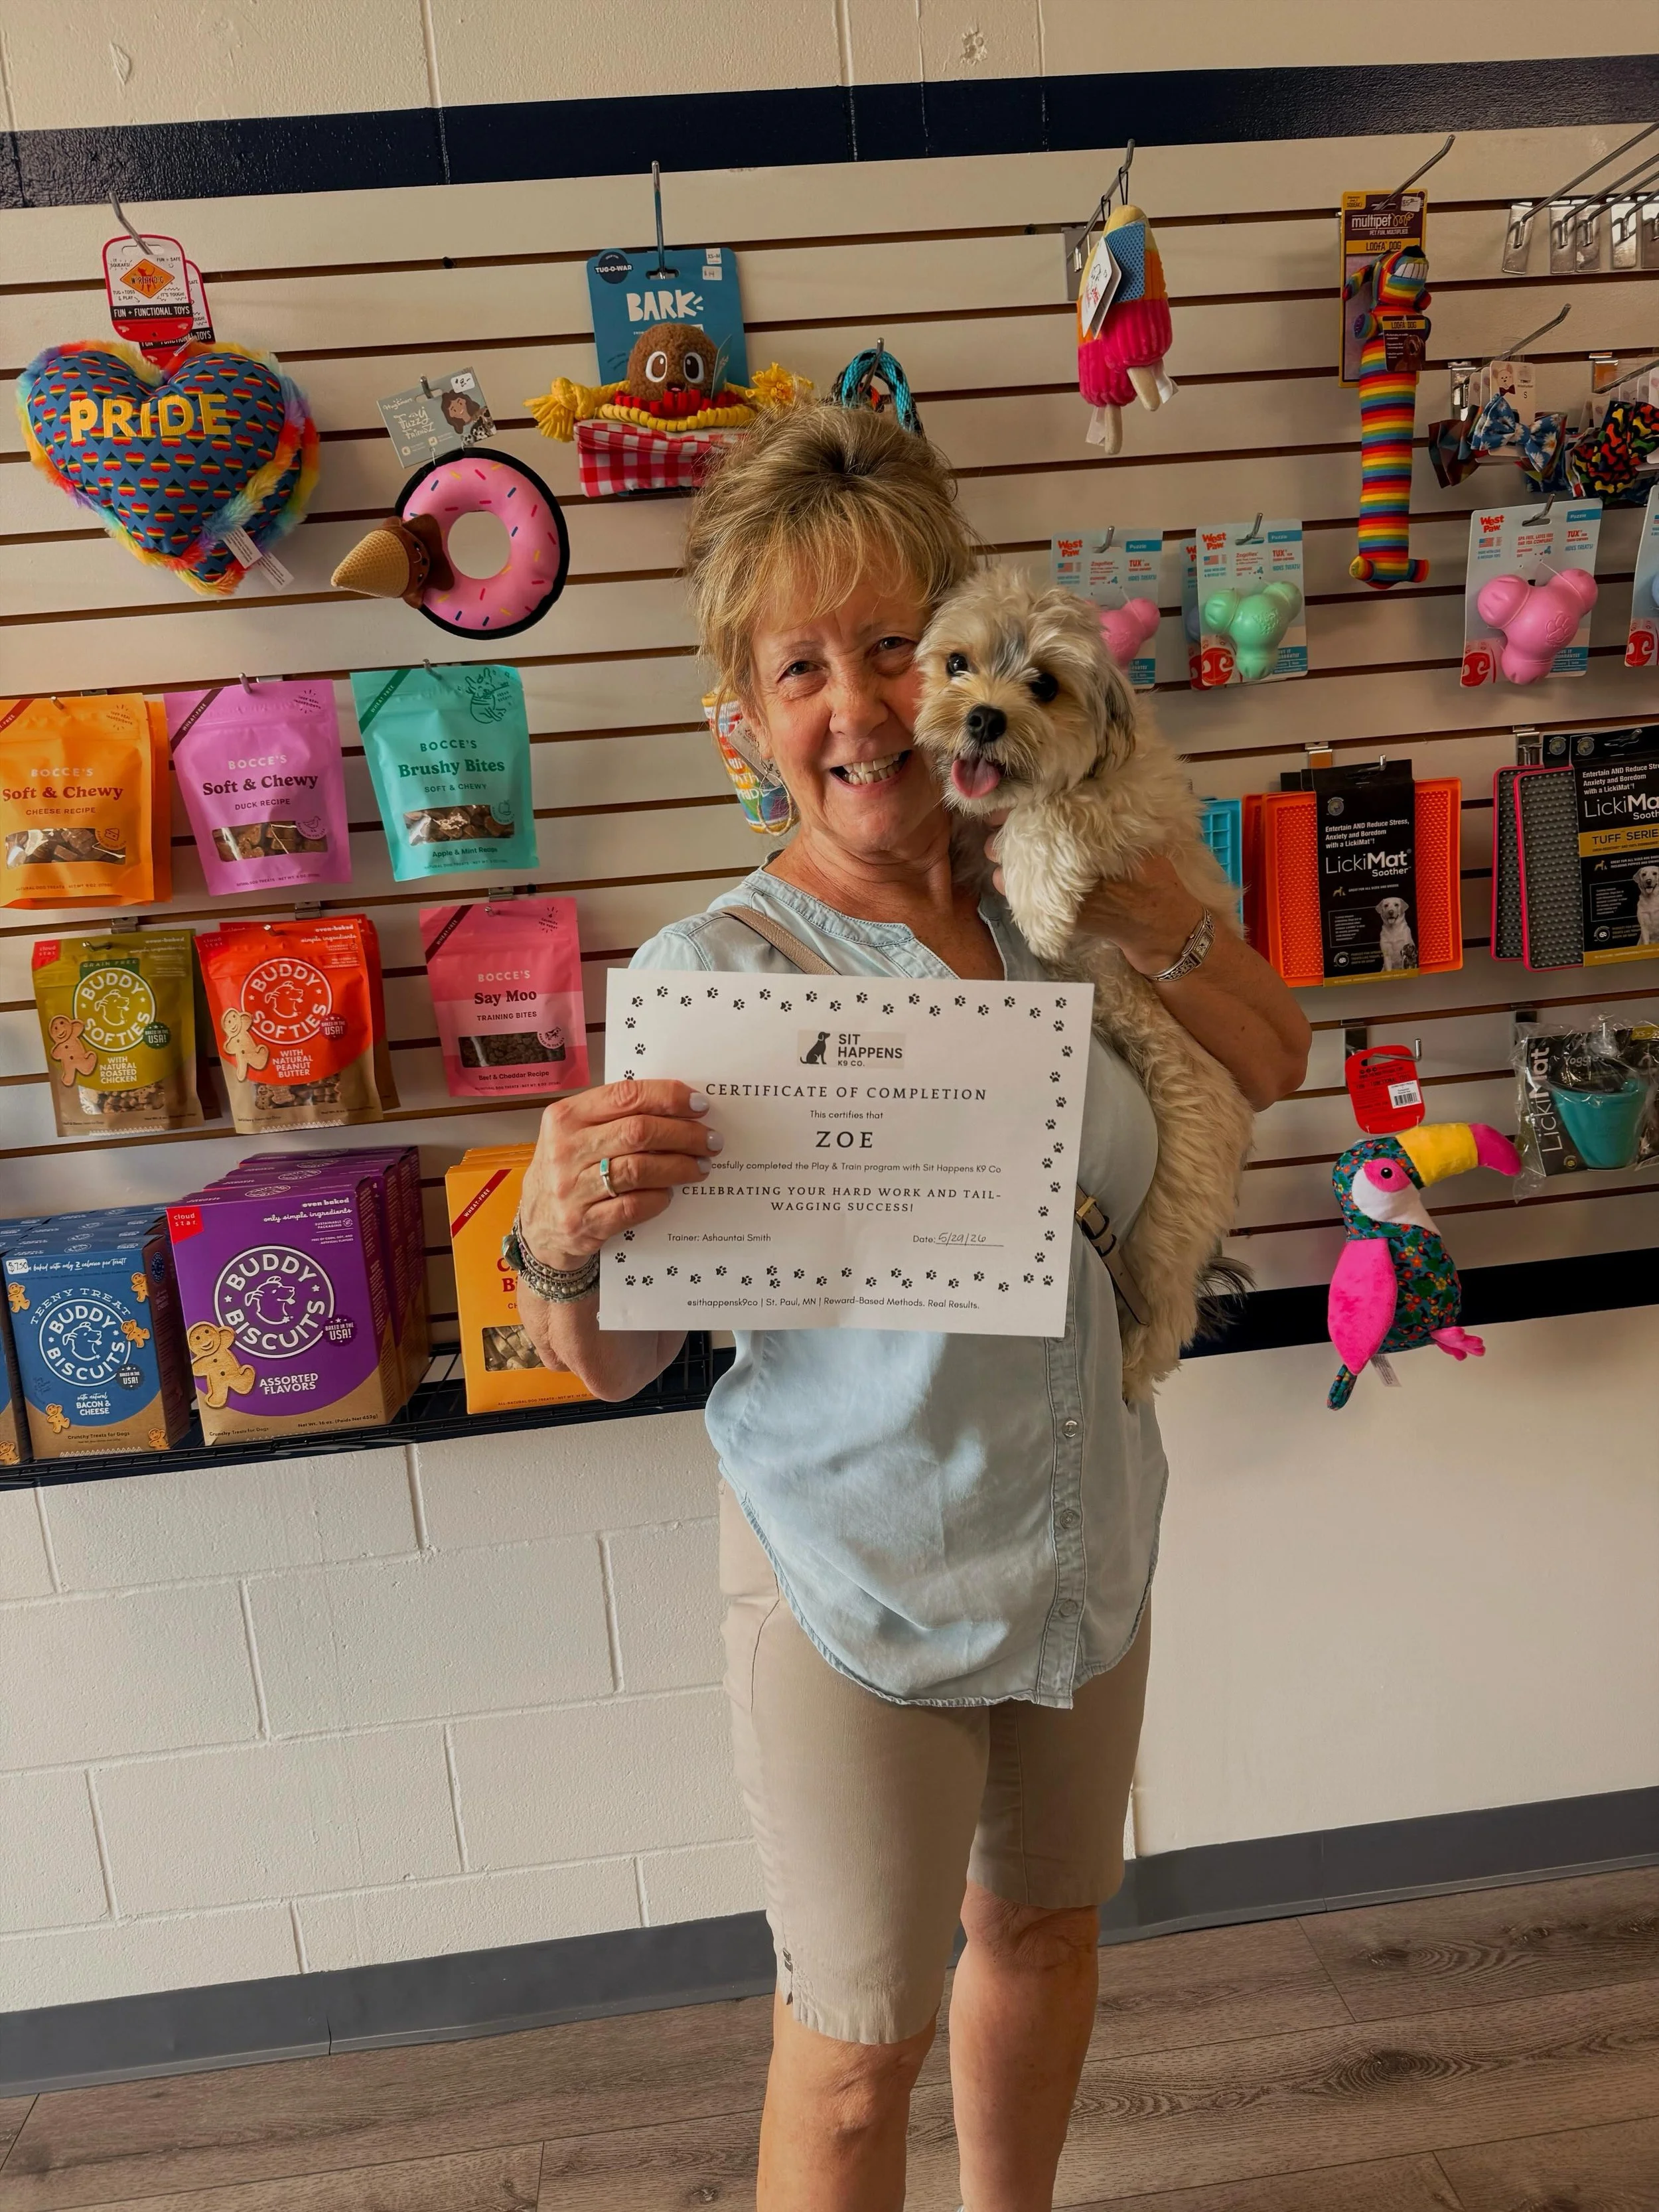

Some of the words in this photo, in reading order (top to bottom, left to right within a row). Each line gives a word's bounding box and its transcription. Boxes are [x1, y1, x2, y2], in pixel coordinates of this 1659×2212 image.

[1352, 214, 1392, 229] multipet
[113, 309, 127, 317] FUN
[134, 307, 173, 317] FUNCTIONAL
[174, 306, 190, 315] TOYS
[626, 289, 698, 322] BARK
[196, 331, 212, 340] TOYS
[70, 394, 232, 442] PRIDE
[1480, 515, 1504, 526] West
[1202, 533, 1226, 542] West
[1058, 540, 1083, 550] West
[182, 703, 206, 731] WHEAT-FREE
[420, 740, 477, 752] BOCCE'S
[228, 755, 287, 770] BOCCE'S
[398, 760, 460, 778] Brushy
[465, 759, 505, 773] Bites
[31, 768, 93, 777] BOCCE'S
[1583, 769, 1609, 778] Entertain
[202, 780, 238, 795] Soft
[243, 778, 257, 791] &
[261, 774, 319, 789] Chewy
[2, 787, 37, 801] Soft
[42, 787, 58, 799] &
[63, 786, 124, 800] Chewy
[1585, 793, 1659, 818] LickiMa
[1633, 810, 1659, 820] Sooth
[1592, 833, 1621, 845] TUFF
[1626, 829, 1659, 841] SERIE
[1326, 851, 1407, 874] LickiMat
[1372, 867, 1409, 877] Soother
[251, 963, 321, 992] BUDDY
[478, 970, 531, 982] BOCCE'S
[81, 972, 144, 1000] BUDDY
[474, 992, 501, 1006] Say
[506, 990, 537, 1002] Moo
[252, 1003, 327, 1039] SOFTIES
[85, 1011, 151, 1046] SOFTIES
[325, 1025, 343, 1035] USA!
[148, 1035, 167, 1043] USA!
[839, 1033, 861, 1045] SIT
[272, 1055, 313, 1065] NATURAL
[838, 1047, 902, 1059] HAPPENS
[278, 1069, 310, 1078] BUTTER
[706, 1084, 827, 1097] CERTIFICATE
[836, 1087, 858, 1098] OF
[867, 1087, 986, 1100] COMPLETION
[829, 1110, 863, 1119] certifies
[816, 1131, 873, 1148] ZOE
[711, 1161, 743, 1171] cesfully
[747, 1161, 792, 1171] completed
[812, 1162, 829, 1172] Play
[864, 1164, 900, 1173] program
[902, 1163, 920, 1171] with
[937, 1164, 974, 1174] Happens
[682, 1186, 781, 1195] CELEBRATING
[788, 1187, 826, 1195] YOUR
[833, 1187, 872, 1196] HARD
[879, 1188, 921, 1197] WORK
[927, 1189, 957, 1198] AND
[964, 1189, 1001, 1199] TAIL-
[464, 1189, 490, 1217] WHEAT-FREE
[770, 1202, 841, 1211] WAGGING
[847, 1203, 914, 1213] SUCCESS!
[283, 1212, 308, 1221] simple
[310, 1208, 352, 1218] ingredients
[938, 1232, 986, 1246] 5/29/26
[226, 1254, 318, 1291] BUDDY
[31, 1288, 73, 1325] TEENY
[80, 1288, 131, 1315] TREAT
[780, 1298, 800, 1307] Paul,
[824, 1297, 884, 1305] Reward-Based
[887, 1297, 925, 1307] Methods.
[928, 1299, 946, 1307] Real
[949, 1300, 979, 1309] Results.
[48, 1305, 116, 1335] BUDDY
[226, 1300, 325, 1350] BISCUITS
[330, 1329, 351, 1340] USA!
[47, 1341, 125, 1380] BISCUITS
[259, 1373, 319, 1387] ASSORTED
[264, 1382, 316, 1395] FLAVORS
